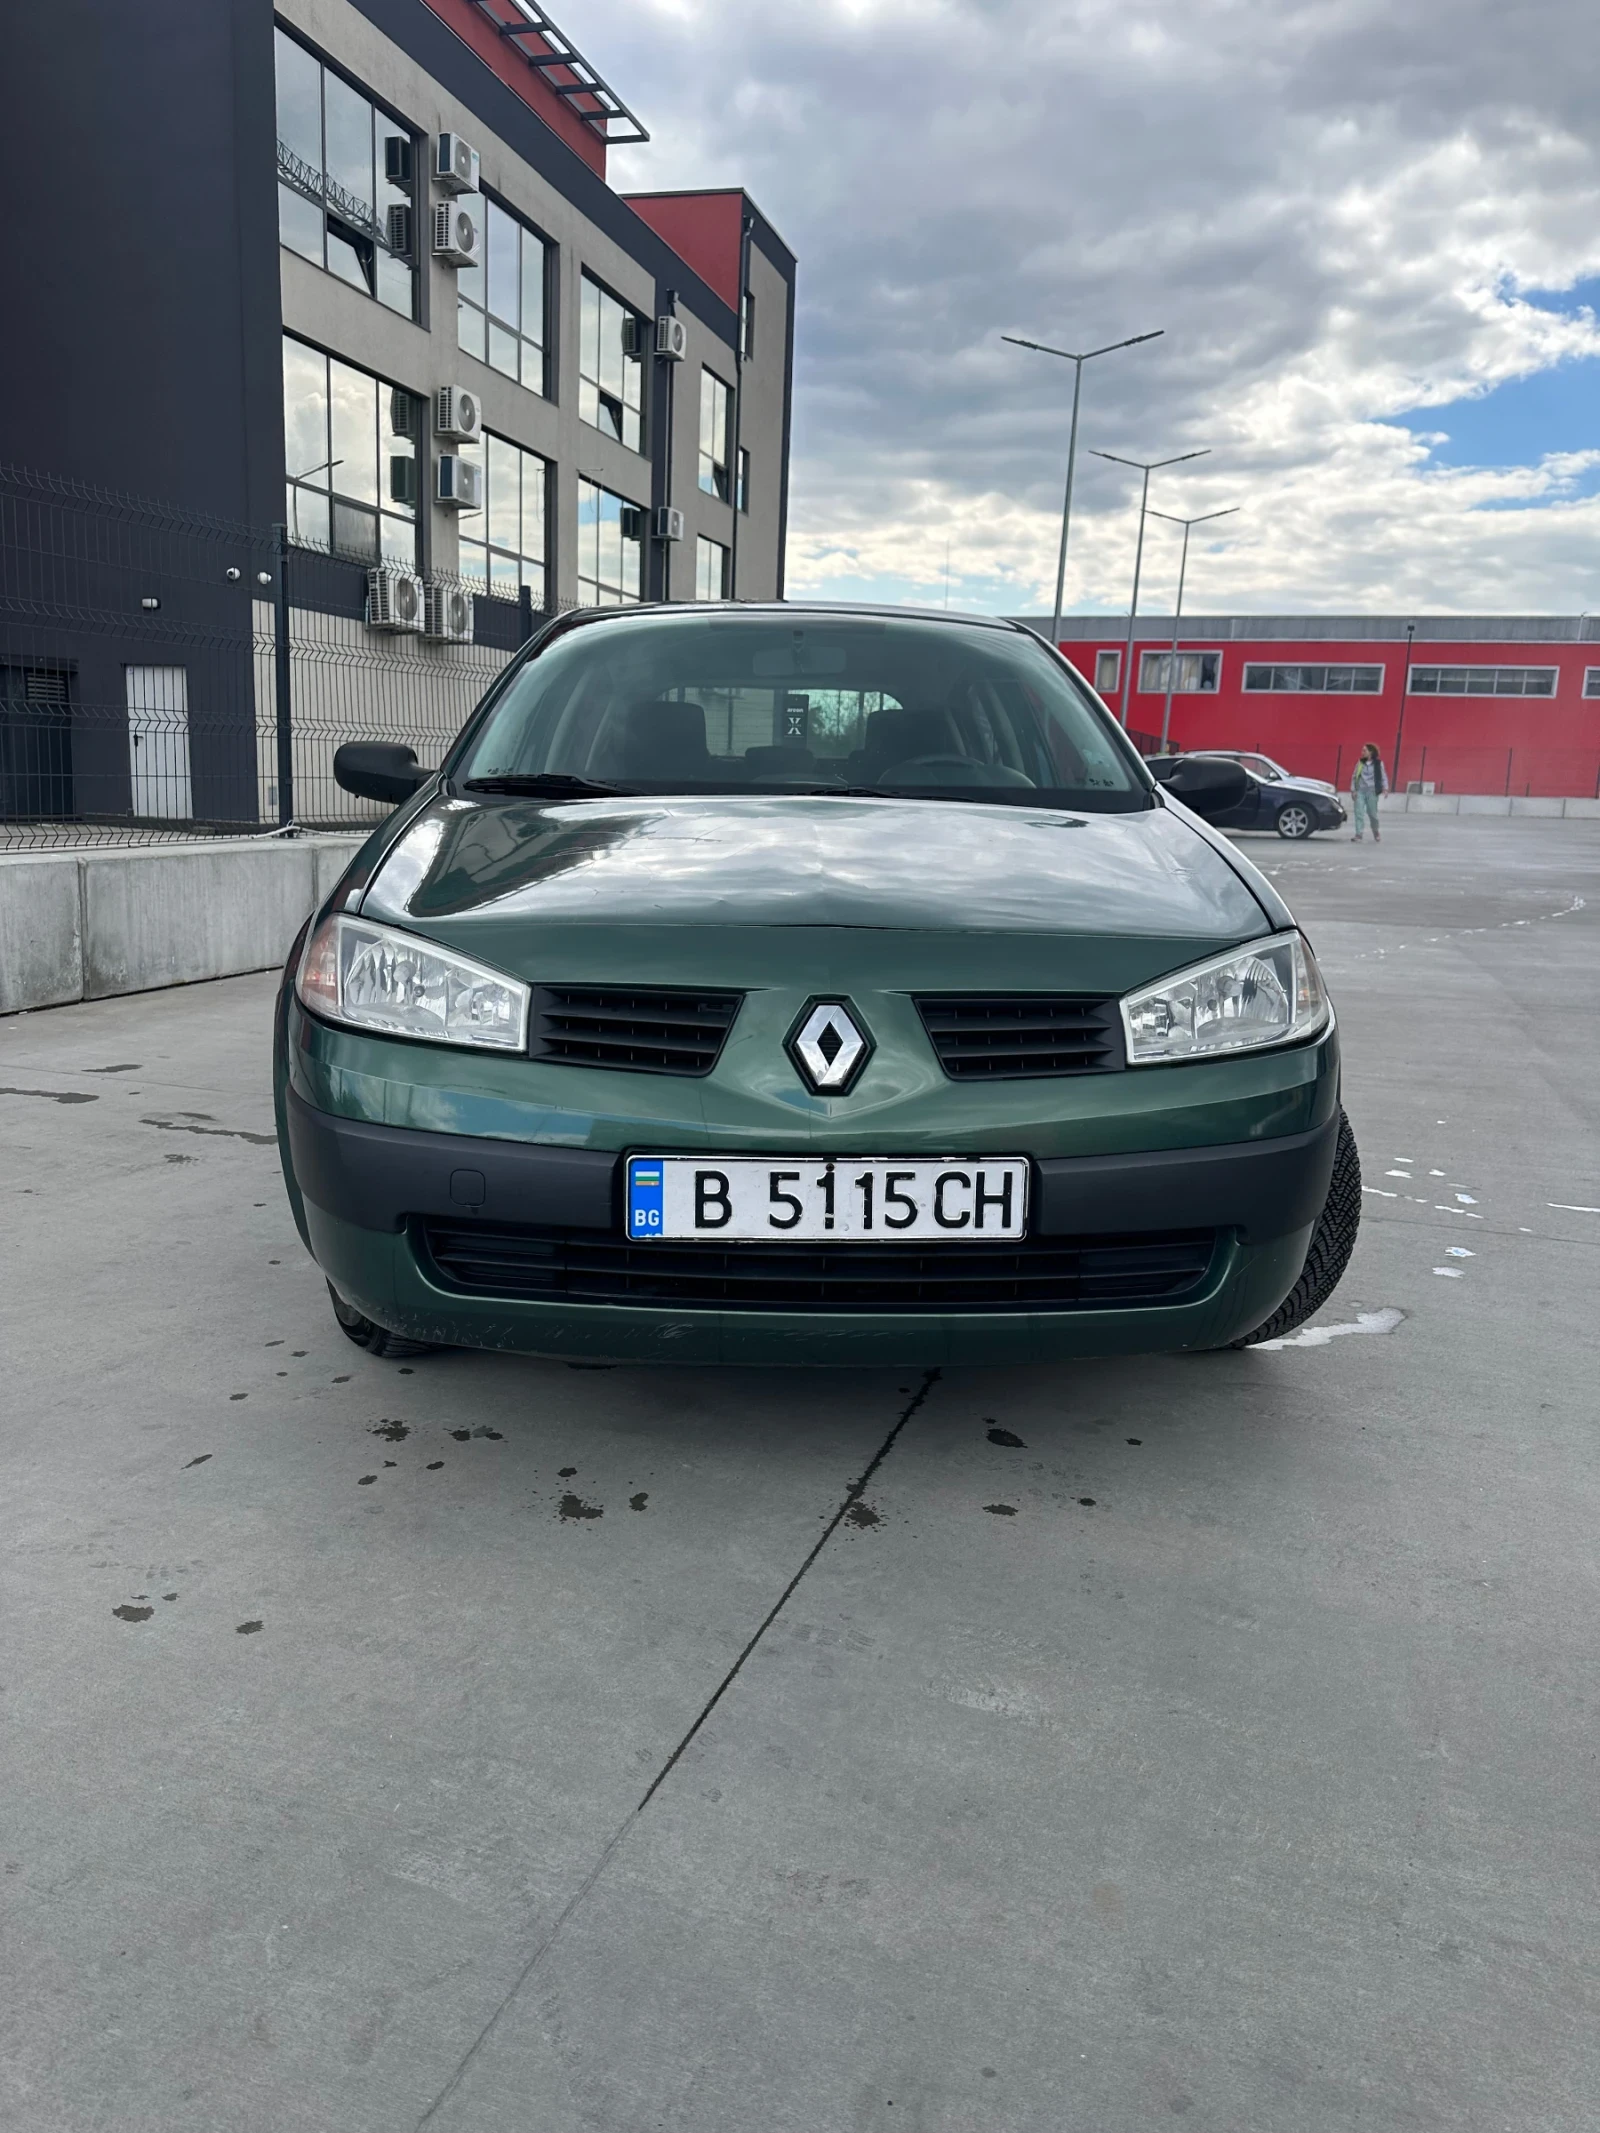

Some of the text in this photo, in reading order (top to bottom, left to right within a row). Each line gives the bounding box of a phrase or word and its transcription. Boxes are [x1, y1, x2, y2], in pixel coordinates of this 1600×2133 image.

[634, 1209, 660, 1227] BG
[694, 1169, 1013, 1230] B 5115 CH
